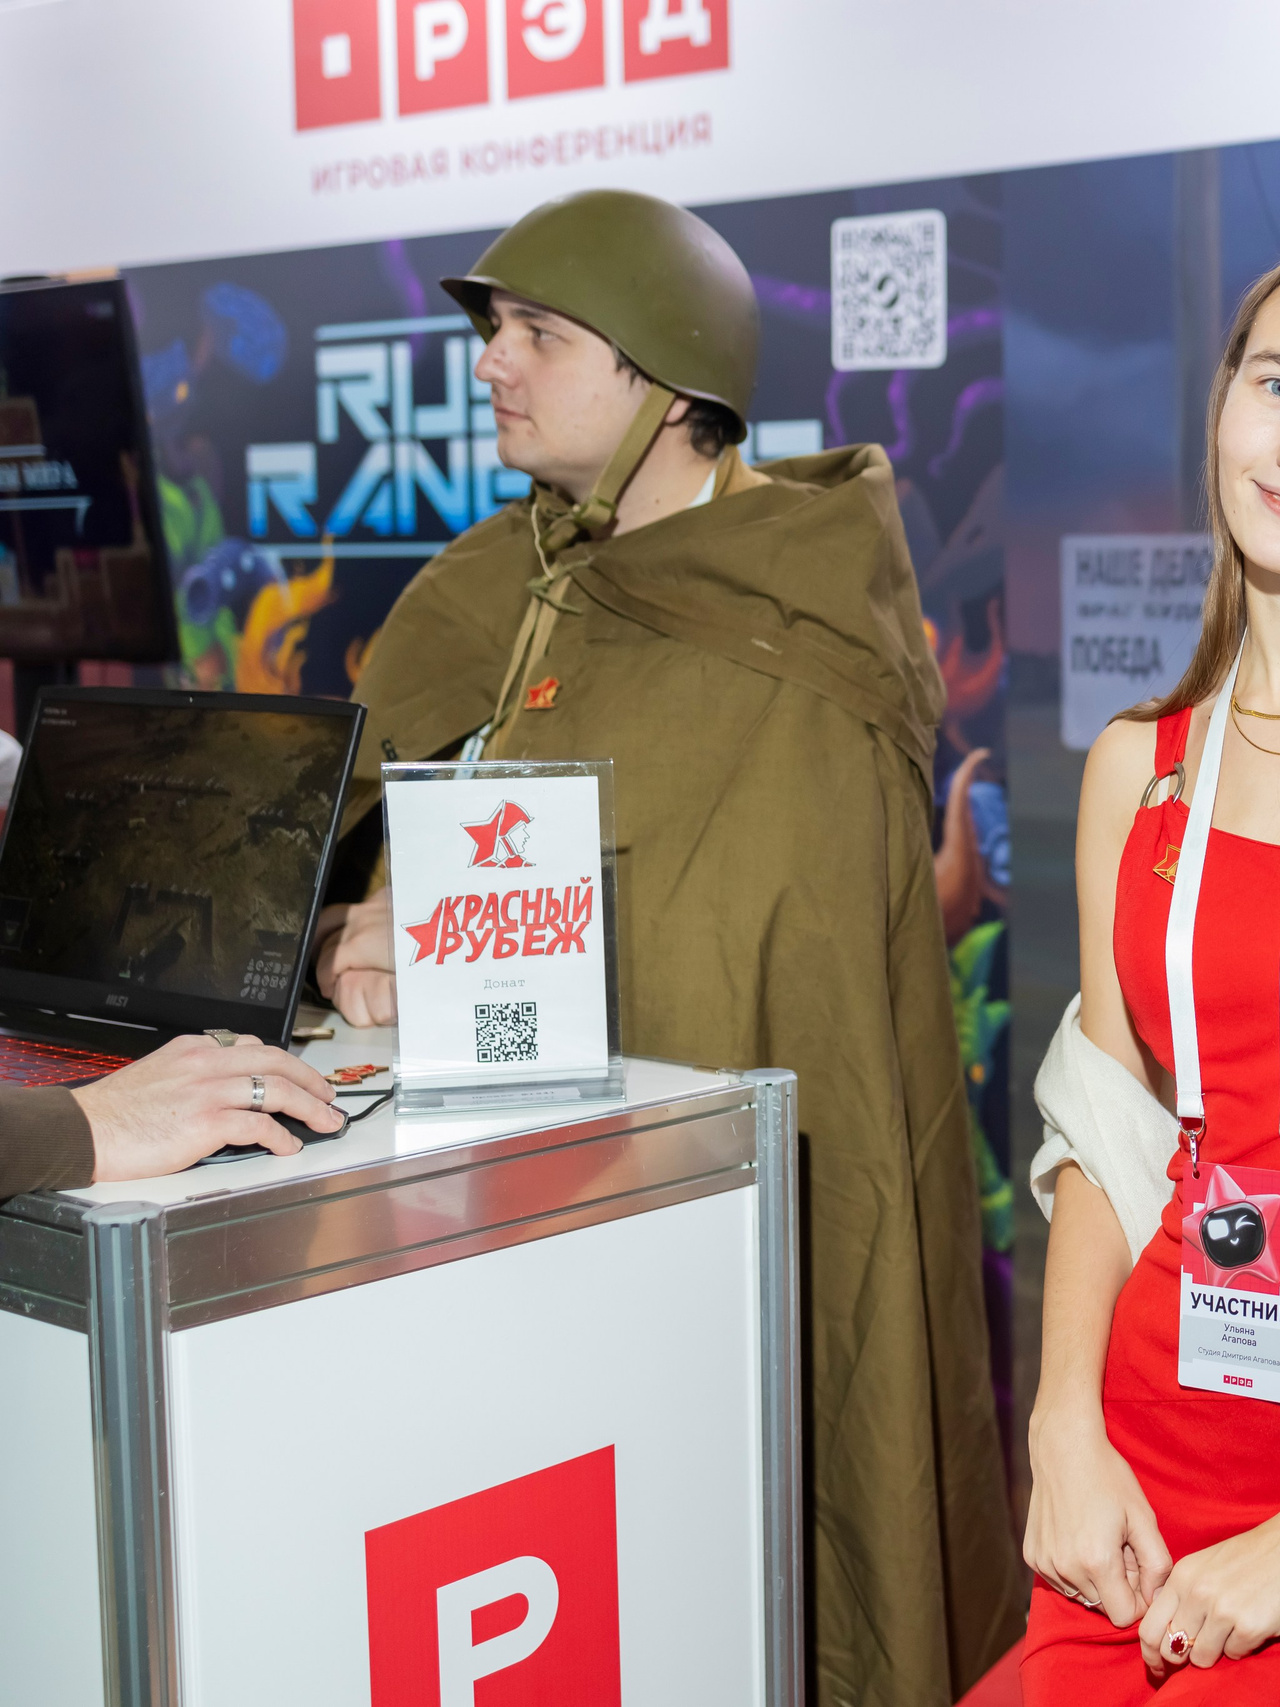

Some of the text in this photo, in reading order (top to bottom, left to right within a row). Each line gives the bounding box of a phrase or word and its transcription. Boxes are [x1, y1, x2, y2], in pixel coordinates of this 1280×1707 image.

[311, 112, 713, 197] ИГРОВАЯ КОНФЕРЕНЦИЯ
[1075, 547, 1142, 588] НАШЕ
[1071, 635, 1163, 683] ПОБЕДА
[443, 876, 594, 933] КРАСНЫЙ
[435, 920, 591, 966] РУБЕЖ
[484, 978, 526, 990] Донат
[1221, 1333, 1258, 1347] Агапова
[1223, 1323, 1256, 1336] Ульяна
[1197, 1346, 1280, 1367] Студия Дмитрия Агапова
